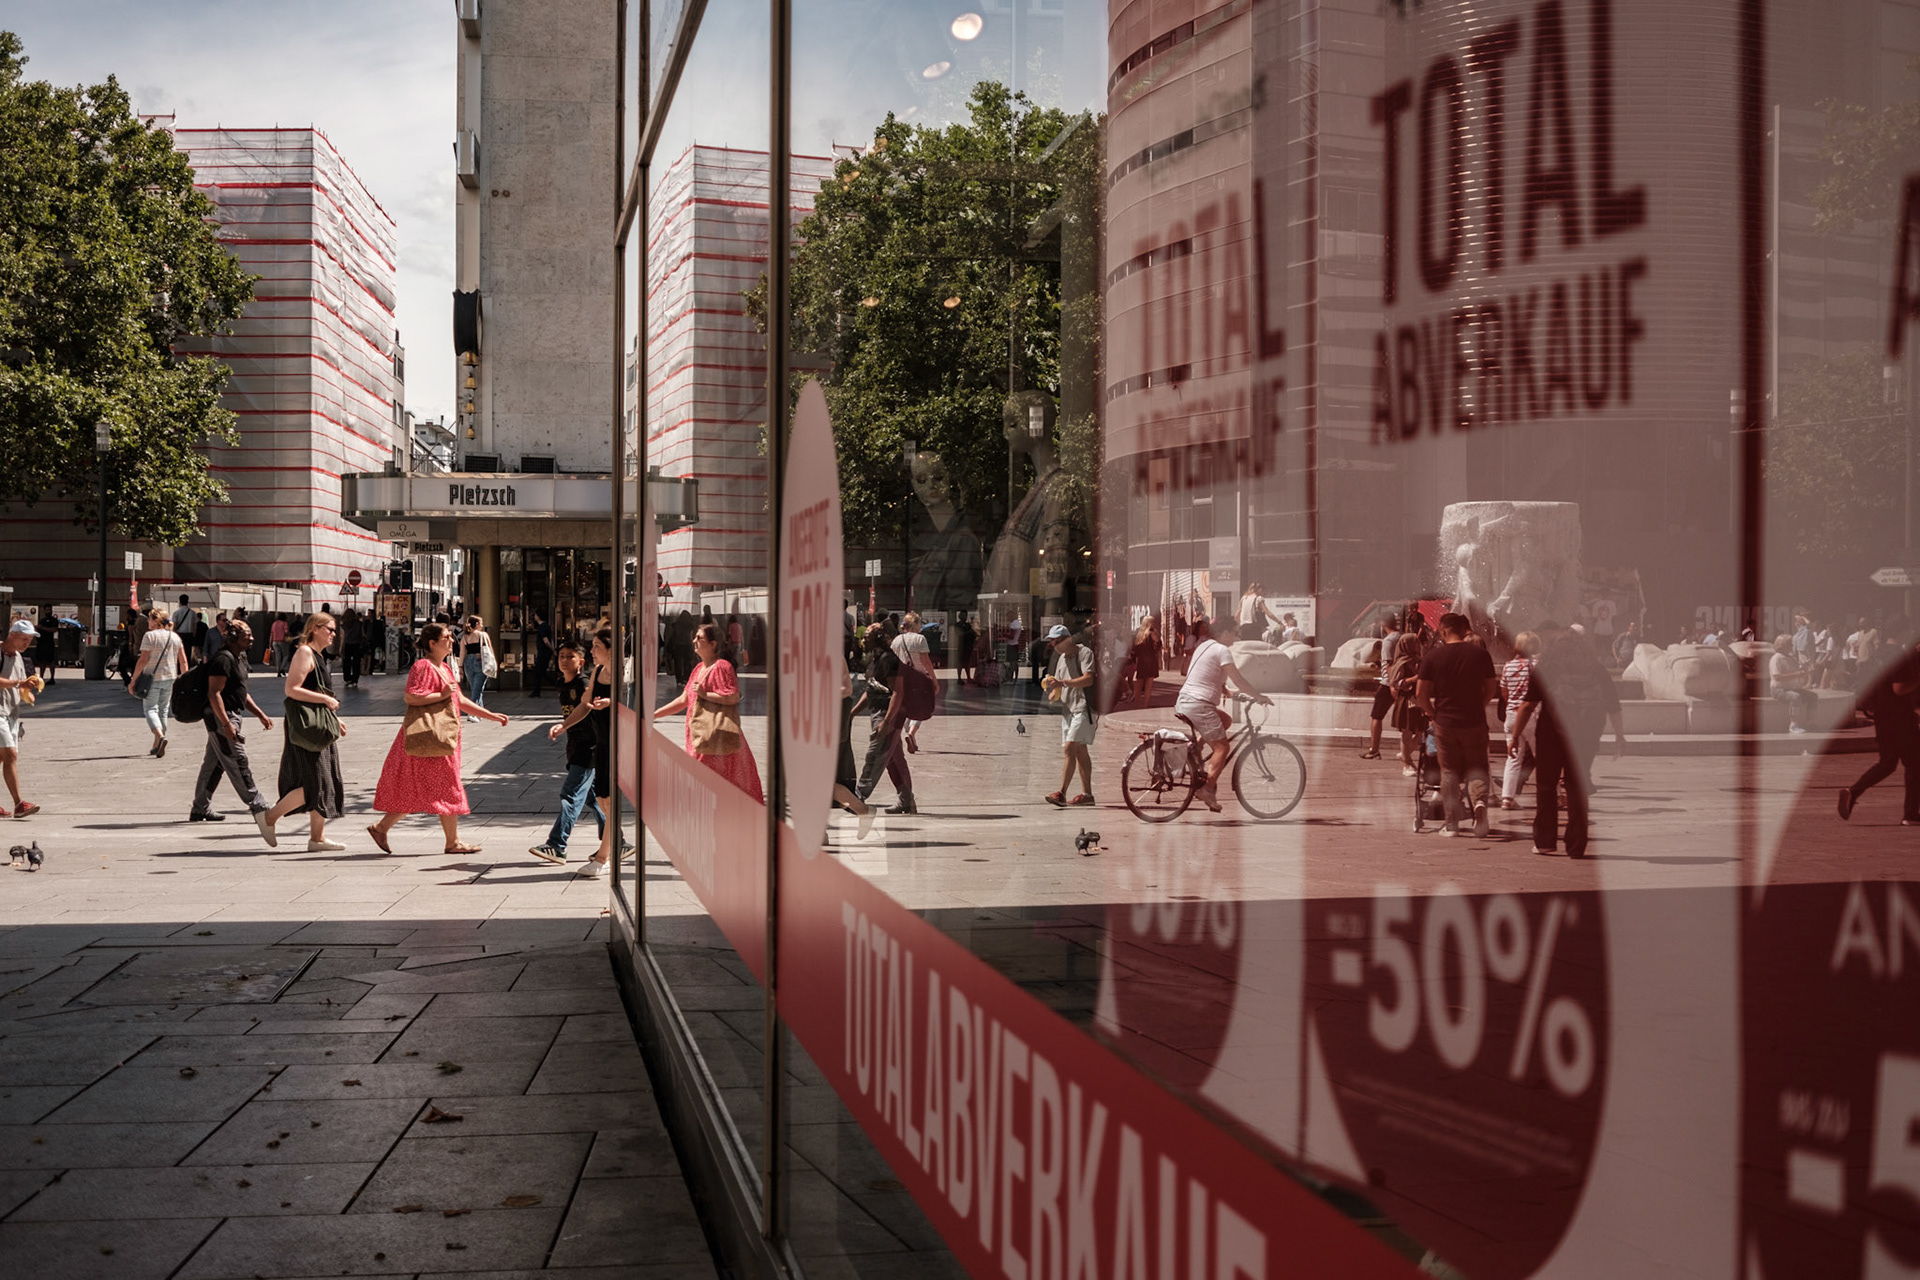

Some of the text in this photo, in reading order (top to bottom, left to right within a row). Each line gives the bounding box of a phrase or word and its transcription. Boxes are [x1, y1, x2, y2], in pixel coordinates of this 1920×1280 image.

[1368, 0, 1648, 308] TOTAL
[1131, 176, 1286, 396] TOTAL
[1369, 255, 1648, 448] ABVERKAUF
[389, 530, 417, 538] OMEGA
[414, 542, 444, 552] Pletzsch
[449, 484, 516, 506] Pletzsch
[783, 581, 833, 750] -50%
[842, 898, 1267, 1280] TOTALABVERKA
